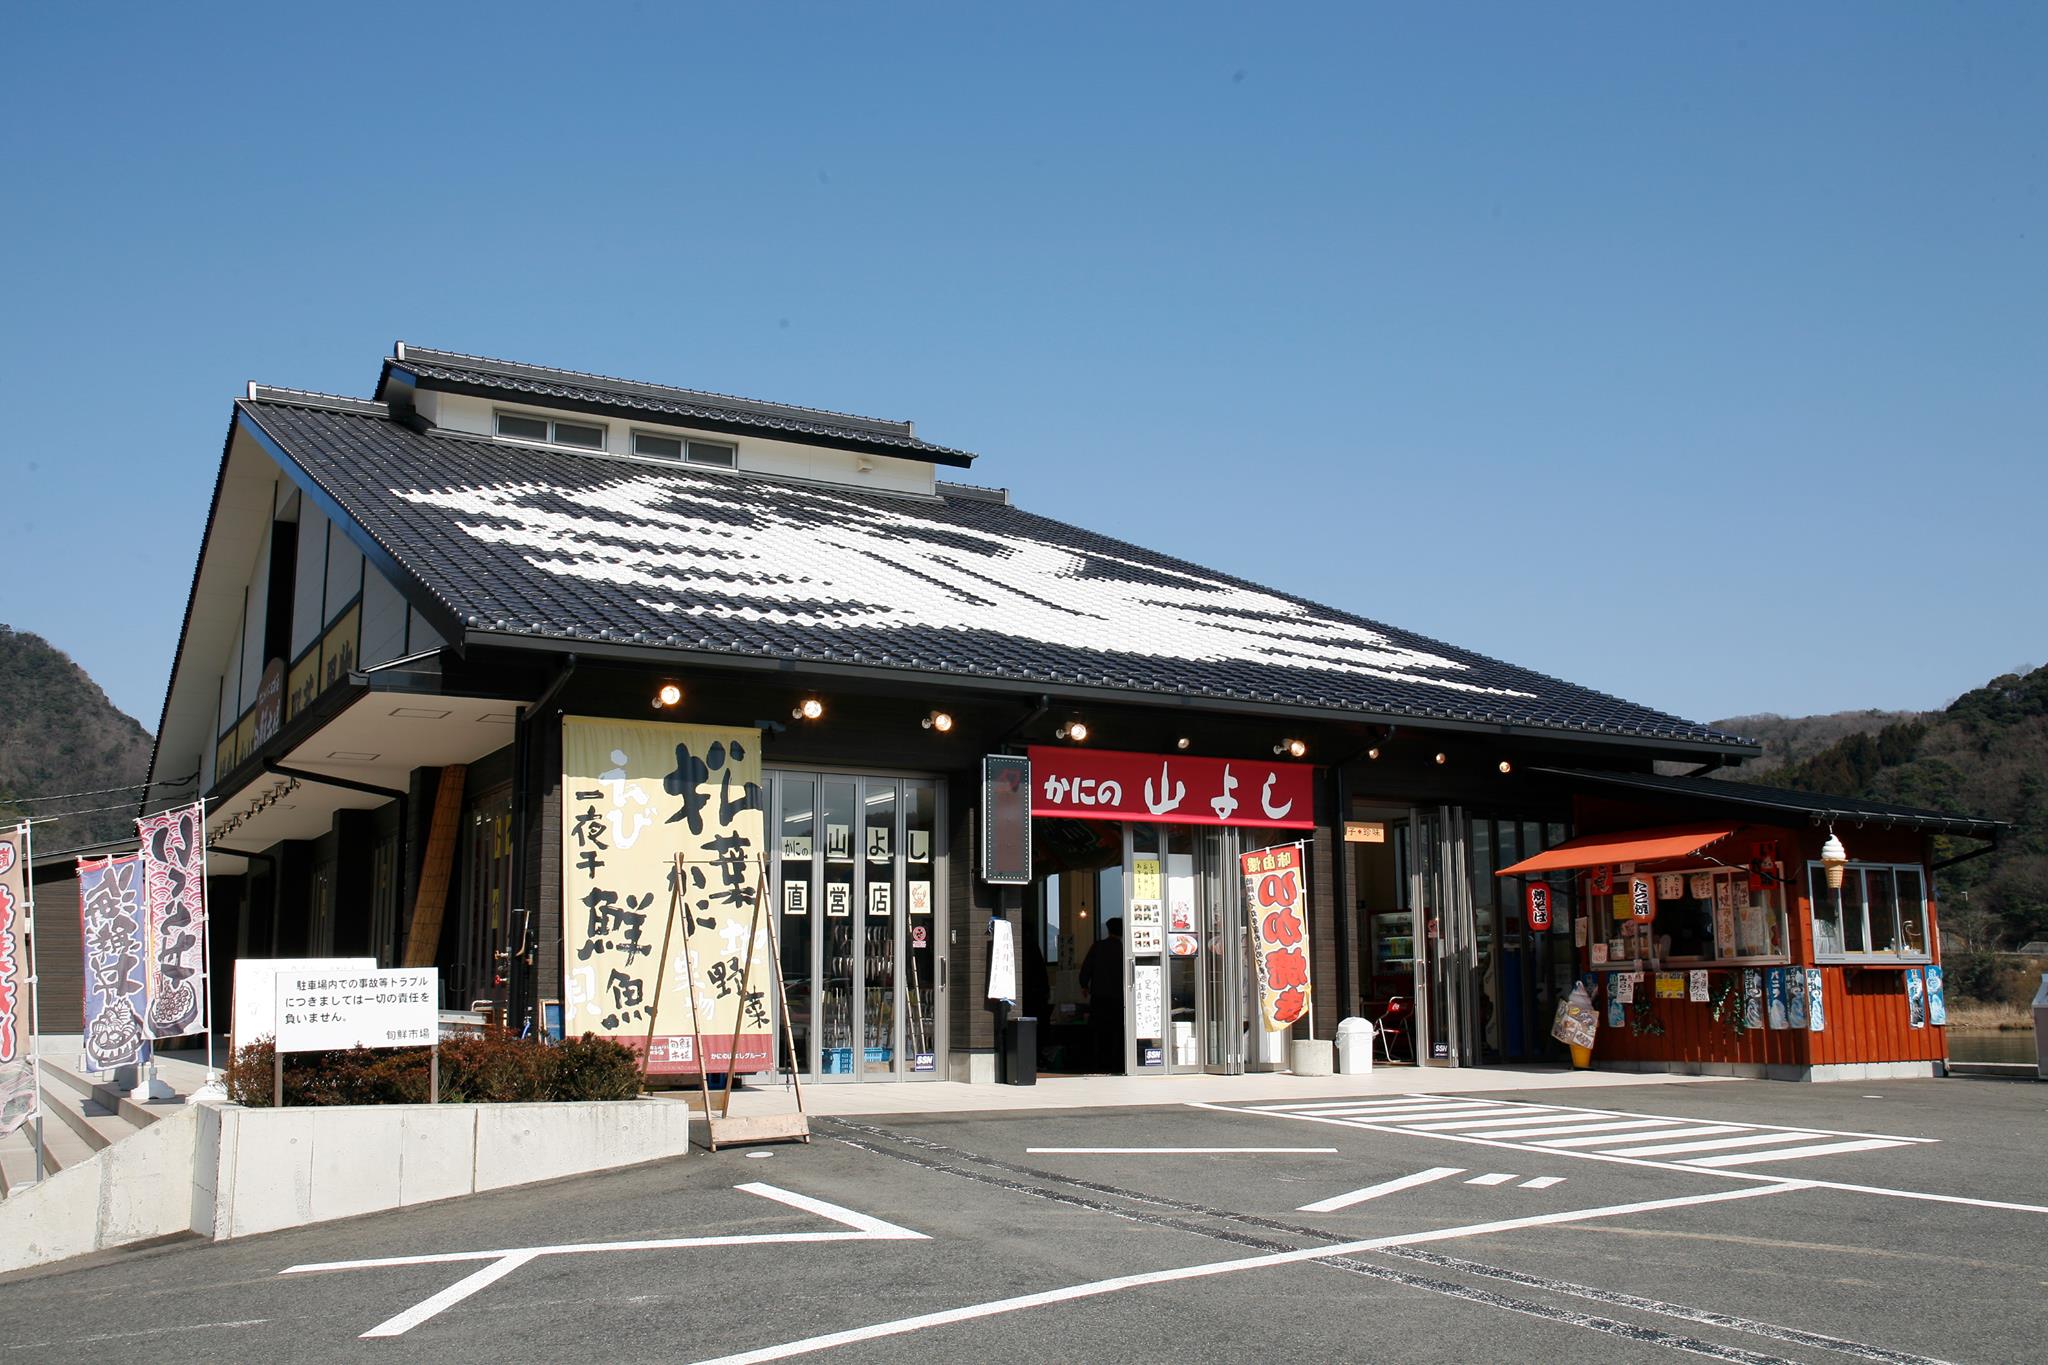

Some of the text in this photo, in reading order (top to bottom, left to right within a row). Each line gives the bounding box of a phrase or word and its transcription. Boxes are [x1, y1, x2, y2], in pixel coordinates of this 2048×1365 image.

[599, 749, 658, 848] えび
[571, 790, 608, 879] 一夜干
[787, 884, 888, 914] 直営店
[1532, 889, 1547, 923] 焼そば
[1633, 879, 1650, 916] たこ焼
[576, 886, 658, 1031] 鮮魚
[296, 976, 429, 991] 駐車場内での事故等トラブル
[285, 992, 430, 1008] につきましては一切の責任を
[285, 1012, 347, 1025] 負いません。
[386, 1028, 430, 1041] 旬鮮市場
[916, 1055, 934, 1065] SSN
